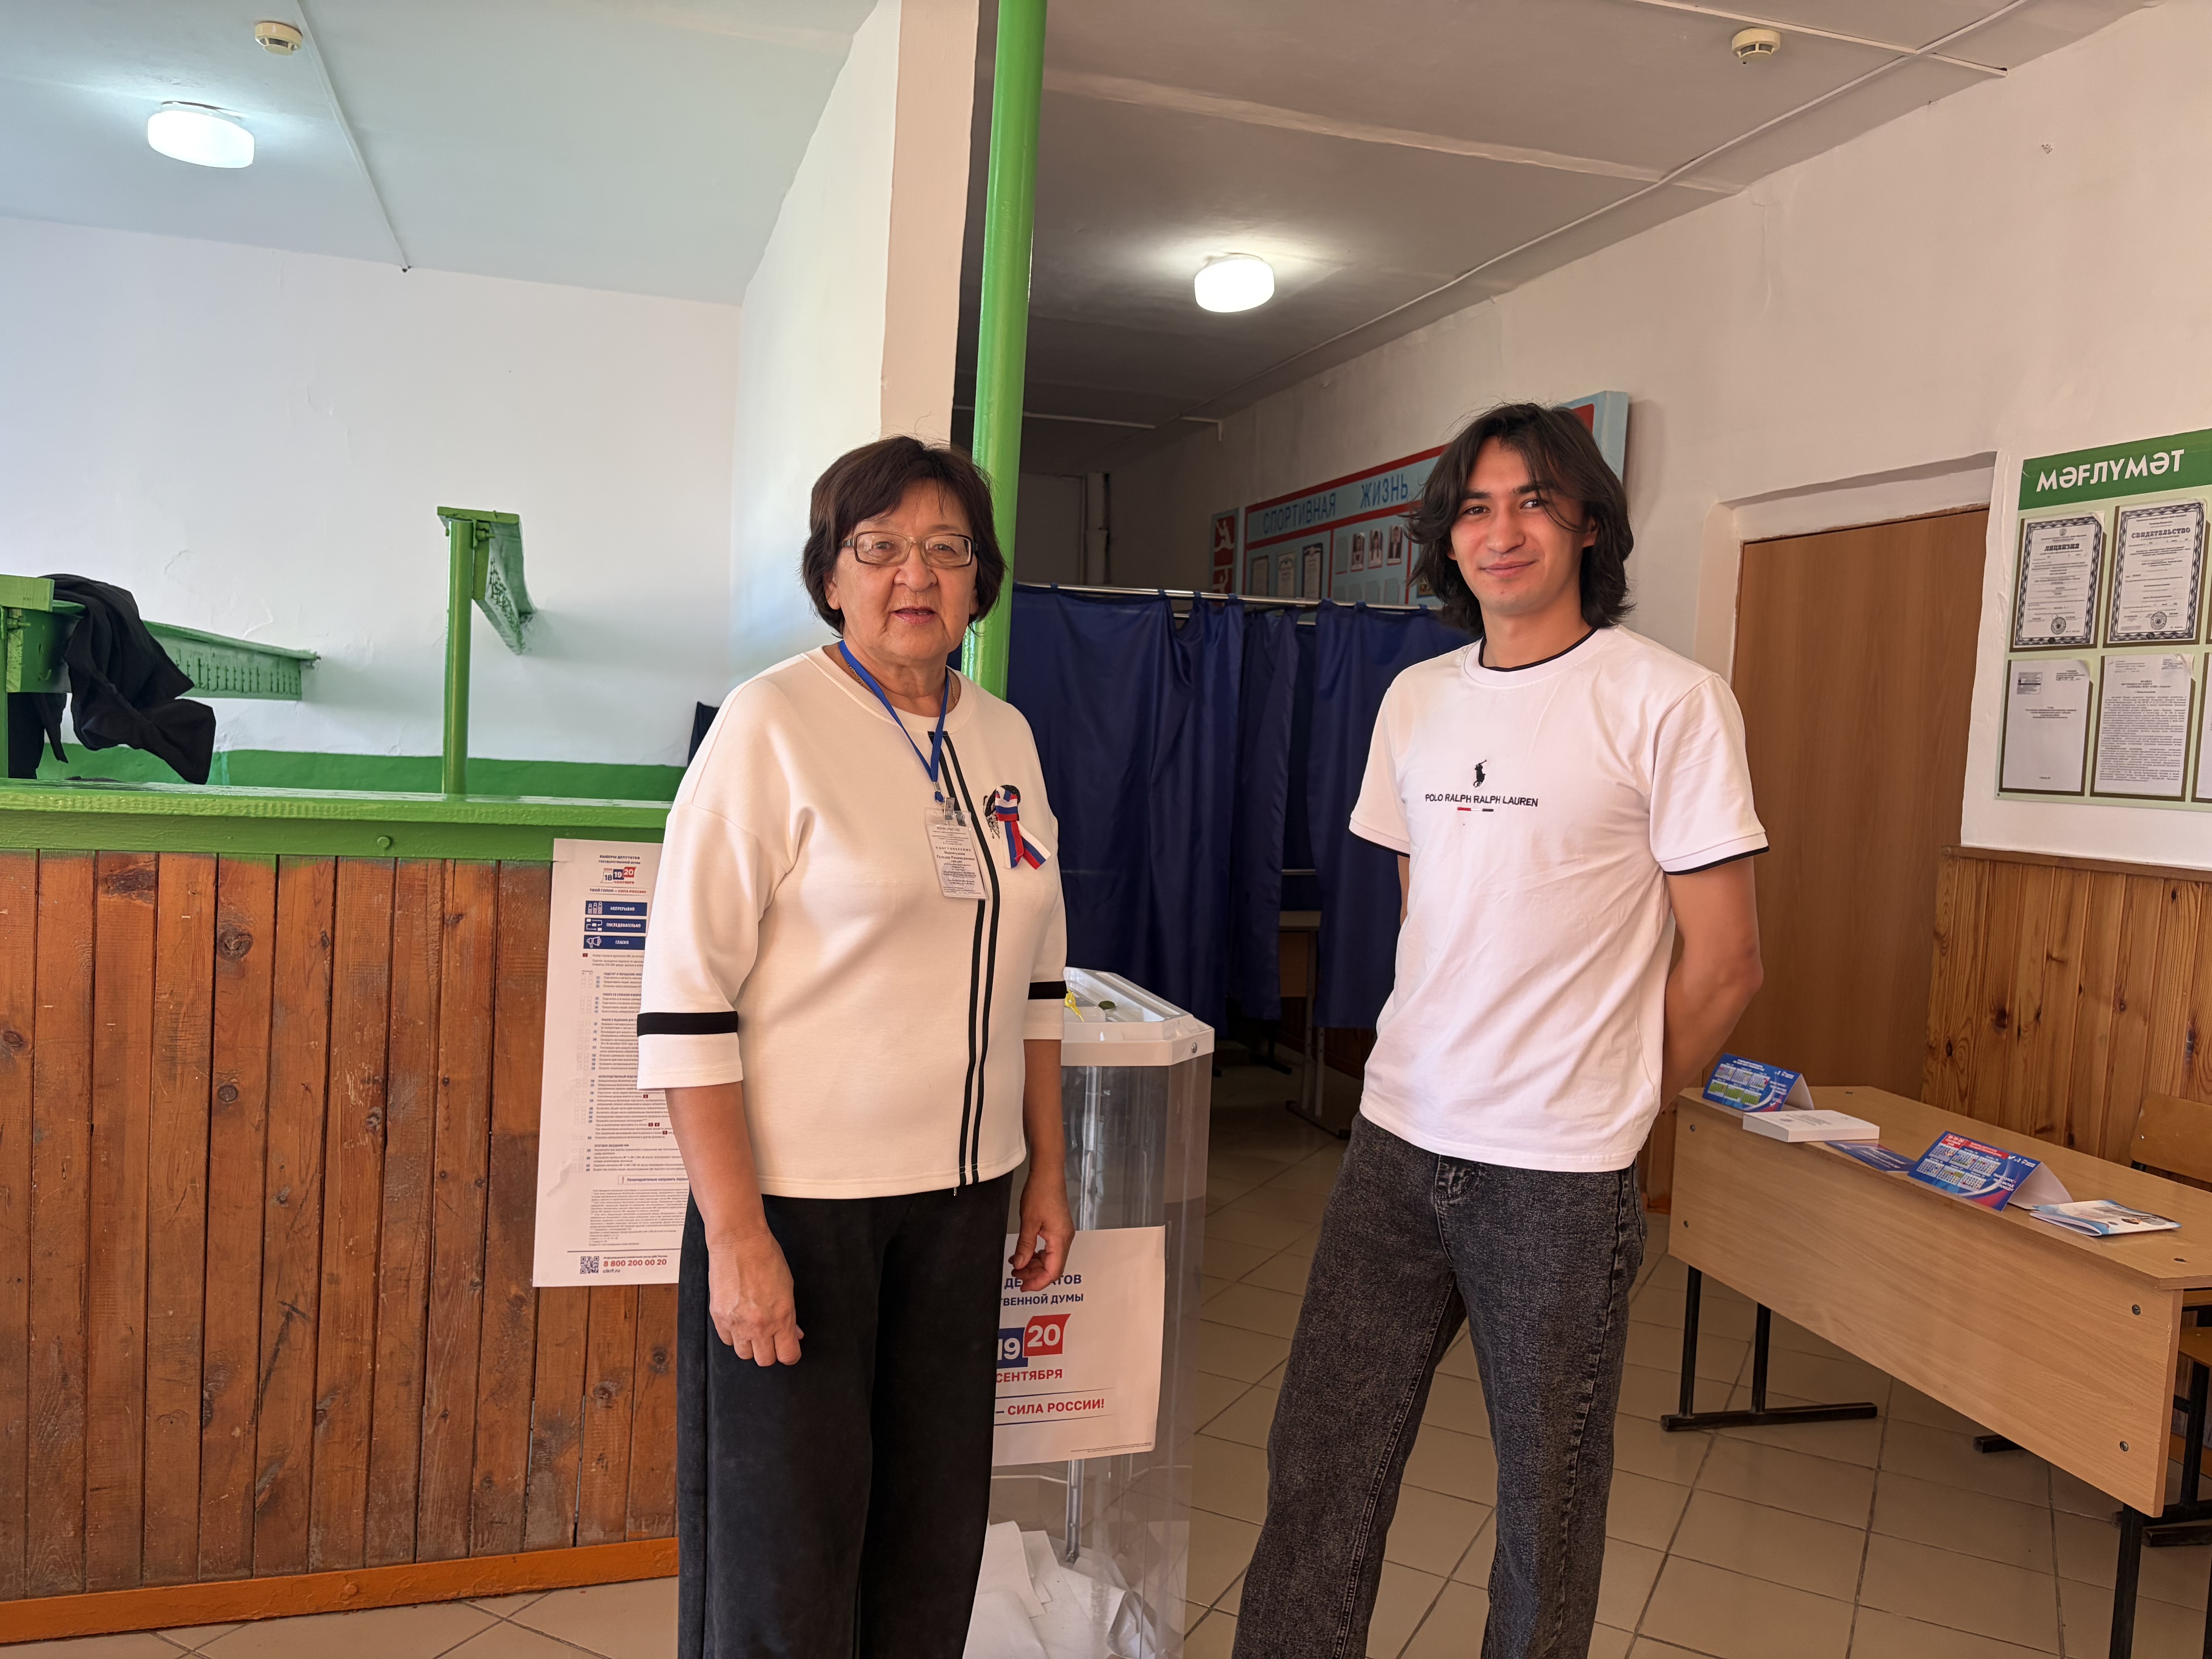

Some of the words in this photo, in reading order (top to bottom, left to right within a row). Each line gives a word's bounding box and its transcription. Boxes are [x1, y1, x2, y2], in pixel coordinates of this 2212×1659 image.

[1263, 493, 1336, 534] СПОРТИВНАЯ
[1360, 474, 1408, 509] ЖИЗНЬ
[2131, 527, 2191, 538] СВИДЕТЕЛЬСТВО
[2044, 543, 2080, 551] ЛИЦЕНЗИЯ
[1425, 794, 1443, 802] POLO
[1445, 794, 1471, 803] RALPH
[1474, 795, 1501, 804] RALPH
[1503, 796, 1539, 807] LAUREN
[1004, 1274, 1082, 1290] ДЕТОВ
[1001, 1294, 1048, 1306] ВЕННОЙ
[1051, 1293, 1084, 1305] ДУМЫ
[1027, 1324, 1061, 1347] 20
[996, 1369, 1062, 1383] СЕНТЯБРЯ
[1008, 1403, 1044, 1415] СИЛА
[1047, 1398, 1104, 1412] РОССИИ!
